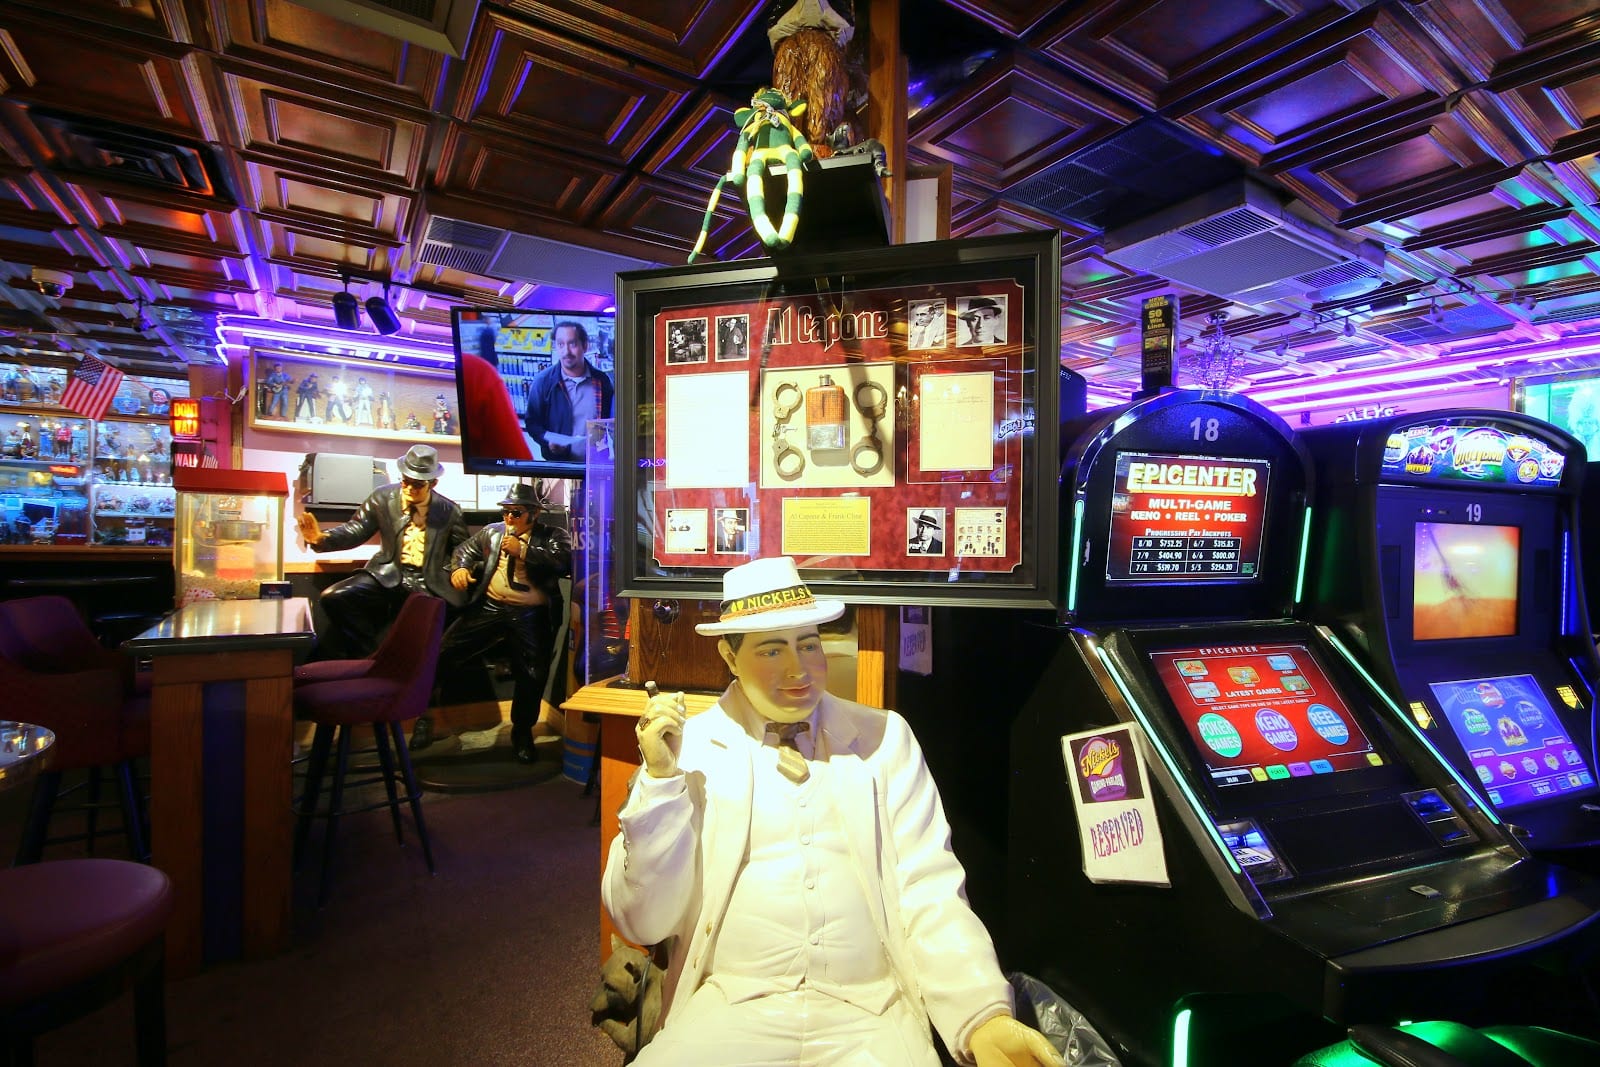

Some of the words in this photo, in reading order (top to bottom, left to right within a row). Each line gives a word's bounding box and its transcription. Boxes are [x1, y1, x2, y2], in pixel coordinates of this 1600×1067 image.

[1145, 301, 1168, 309] GAMES
[1149, 309, 1162, 318] 50
[765, 306, 792, 345] Al
[797, 306, 889, 352] Capone
[1190, 417, 1219, 441] 18
[1126, 462, 1257, 497] EPICENTER
[1148, 499, 1232, 510] MULTI-GAME
[1131, 510, 1161, 520] KENO
[1175, 511, 1200, 521] REEL
[1214, 513, 1247, 522] POKER
[1466, 503, 1482, 522] 19
[746, 587, 807, 609] NICKELS
[1200, 646, 1258, 656] EPICENTER
[1225, 689, 1254, 698] LATEST
[1255, 687, 1283, 696] GAMES
[1257, 715, 1290, 731] KENO
[1311, 710, 1340, 725] REEL
[1197, 720, 1235, 736] POKER
[1318, 725, 1349, 738] GAMES
[1207, 735, 1242, 750] GAMES
[1264, 731, 1298, 745] GAMES
[1090, 807, 1144, 859] RESERVED
